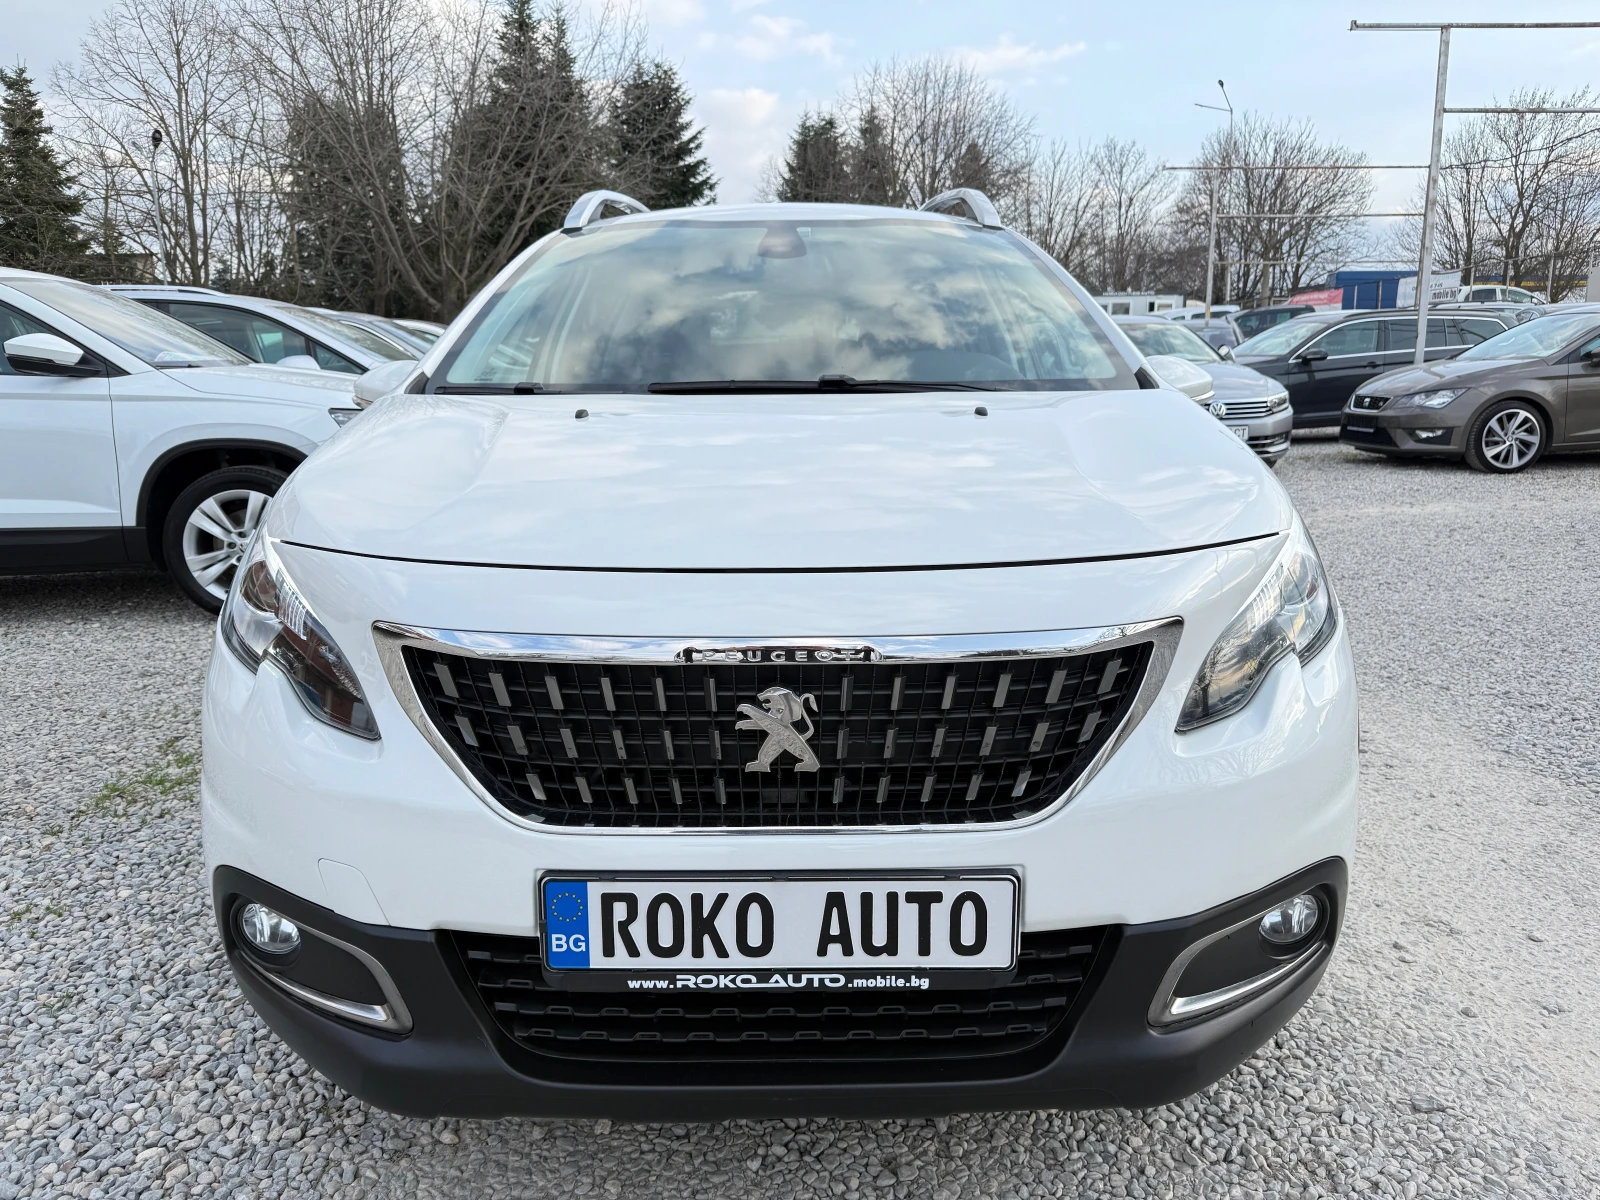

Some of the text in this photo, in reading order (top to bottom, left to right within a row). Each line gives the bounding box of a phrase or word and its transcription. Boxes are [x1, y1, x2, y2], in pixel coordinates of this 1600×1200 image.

[702, 650, 855, 662] PEUGEOT
[600, 890, 988, 958] ROKO AUTO
[551, 934, 587, 952] BG
